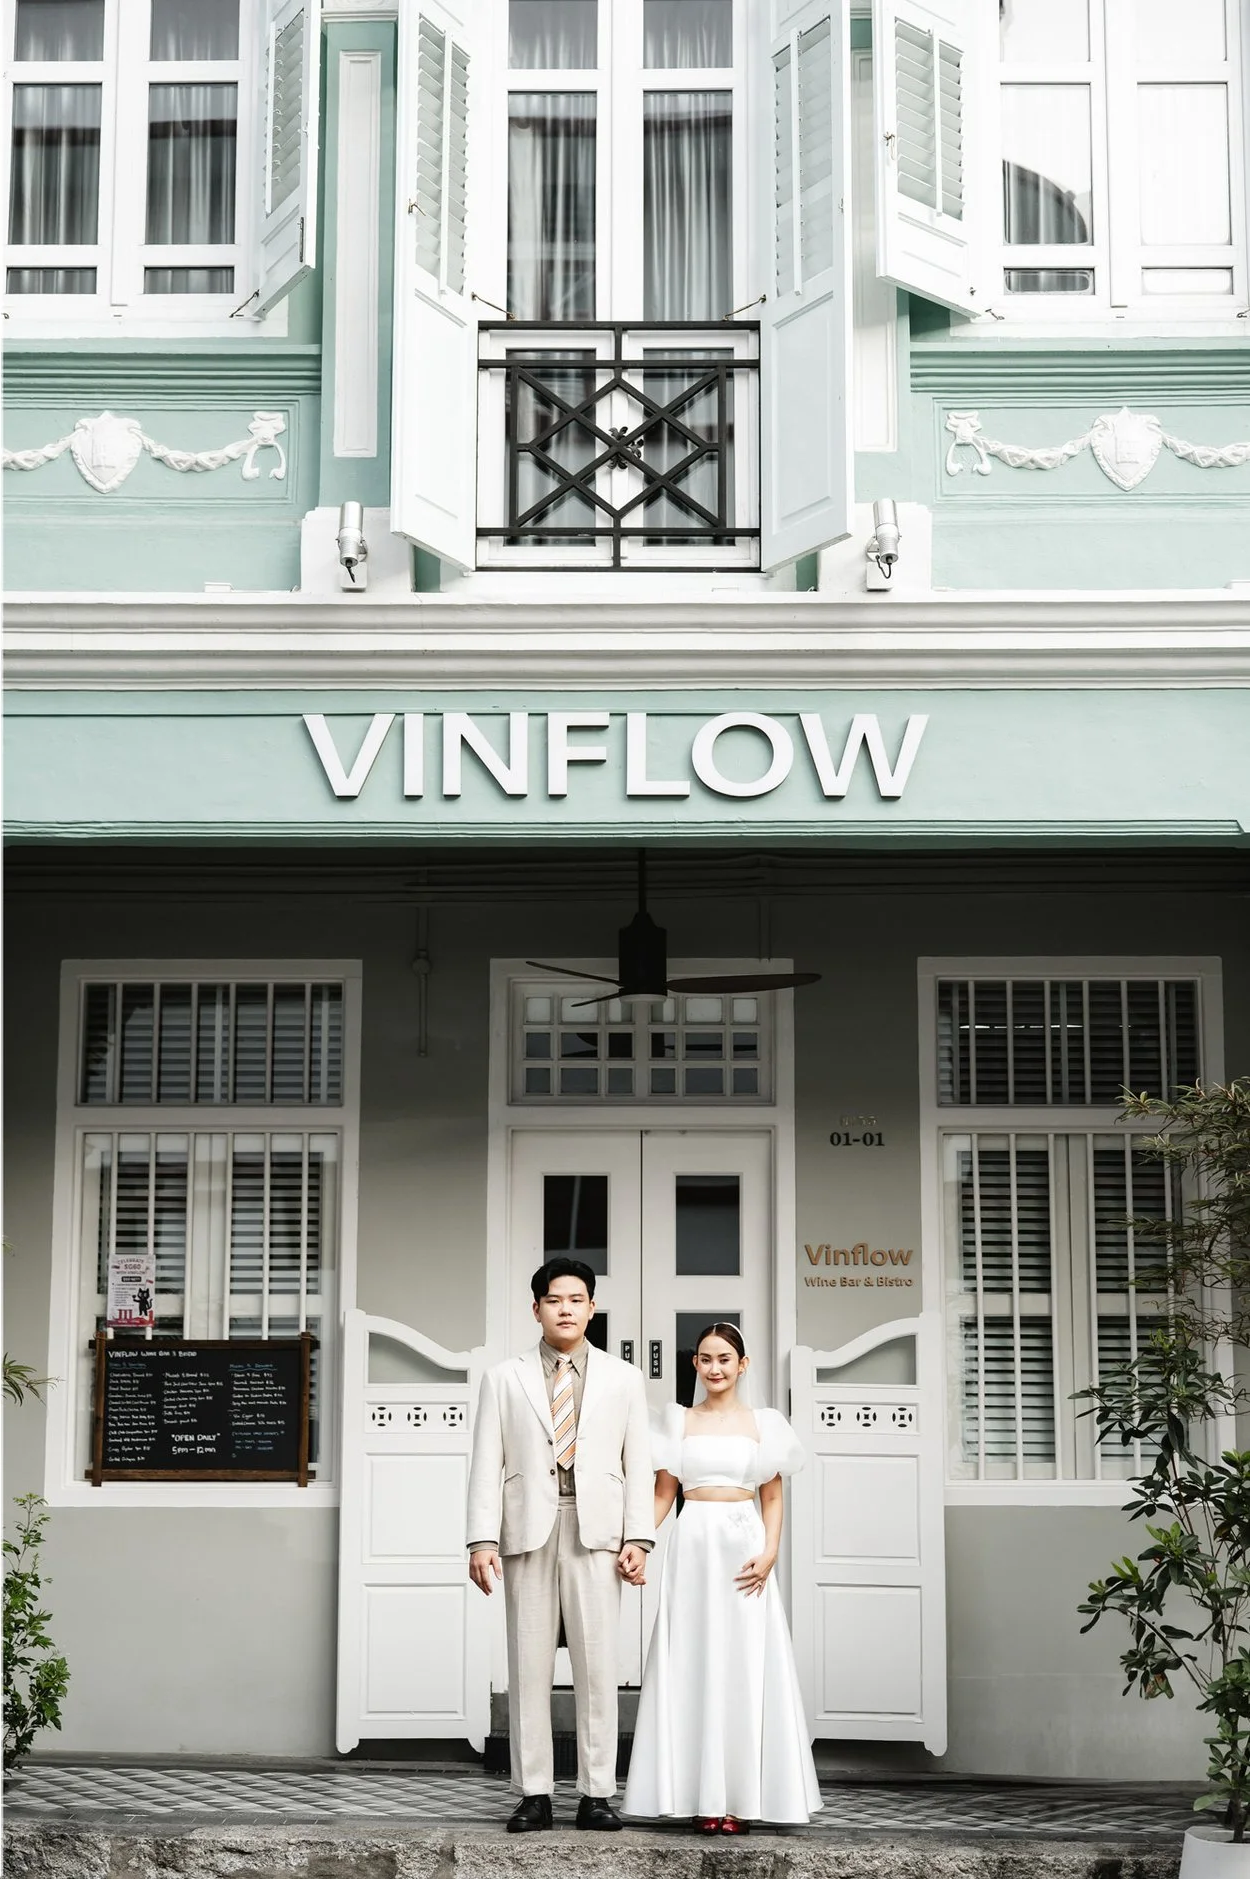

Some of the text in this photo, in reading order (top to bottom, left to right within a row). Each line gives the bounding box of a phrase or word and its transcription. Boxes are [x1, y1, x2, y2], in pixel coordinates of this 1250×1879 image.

[301, 711, 930, 799] VINFLOW
[829, 1132, 885, 1147] 01-01
[804, 1243, 913, 1266] Vinflow
[804, 1276, 913, 1287] Wine Bar & Bistro
